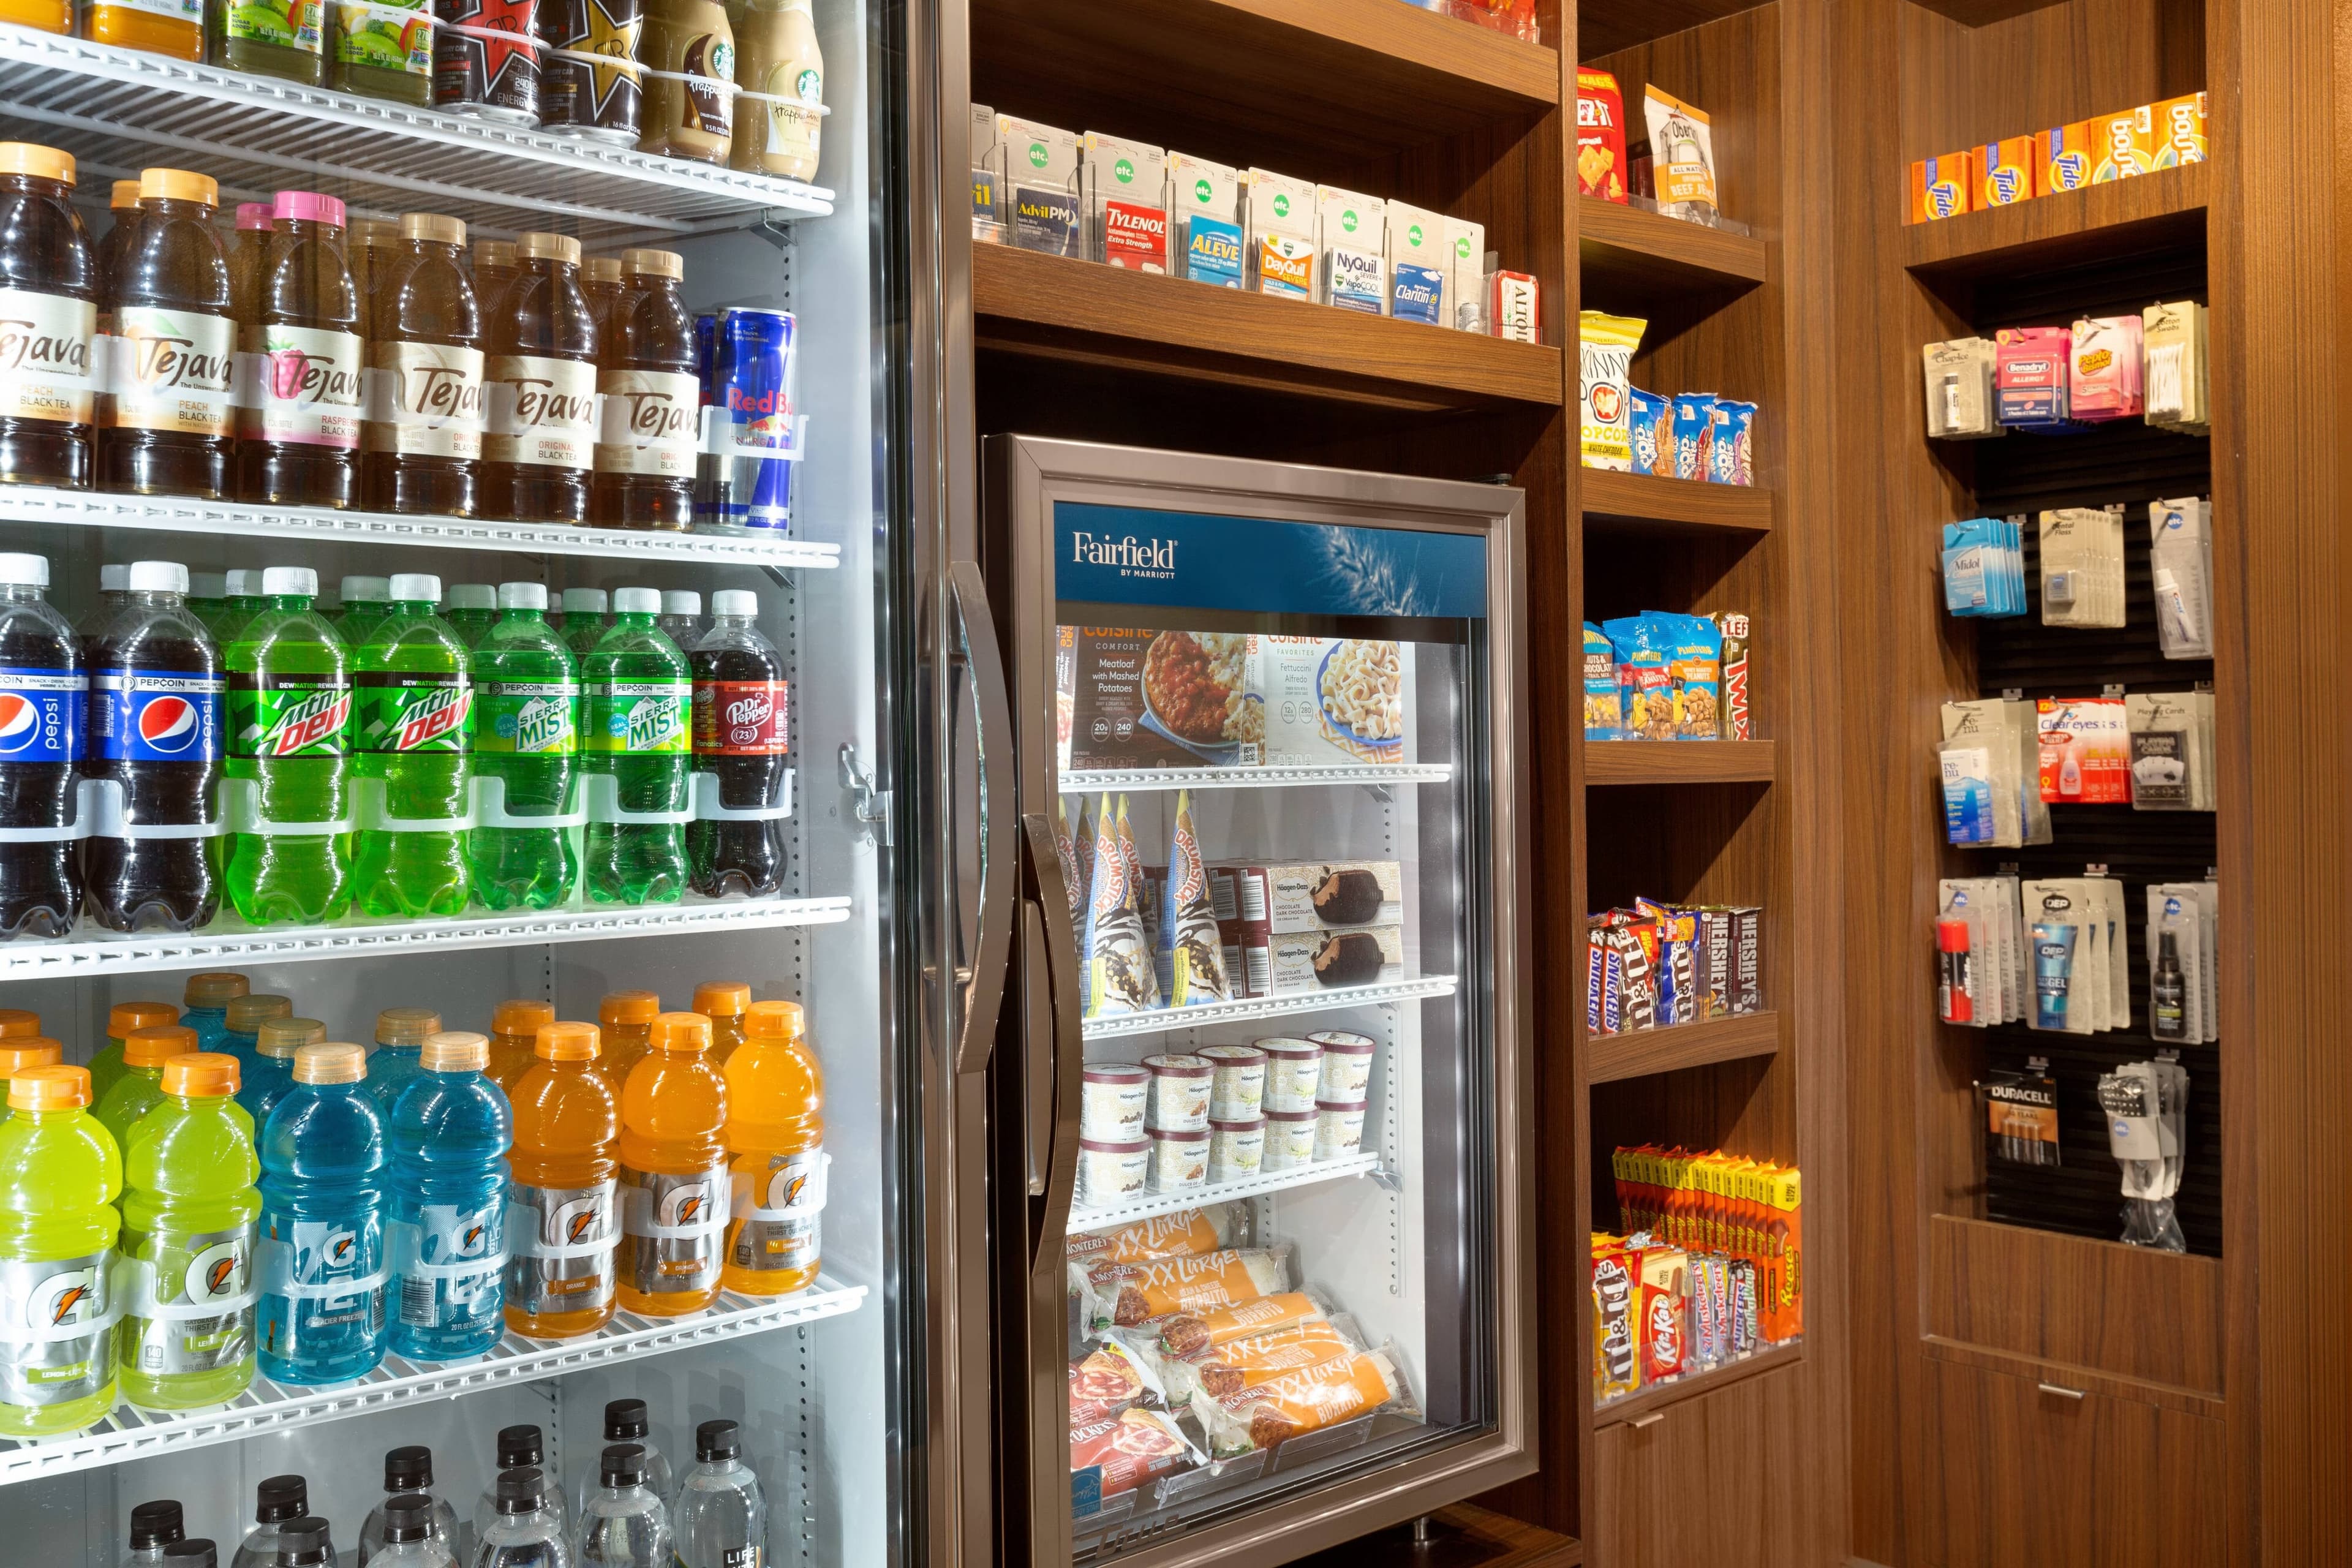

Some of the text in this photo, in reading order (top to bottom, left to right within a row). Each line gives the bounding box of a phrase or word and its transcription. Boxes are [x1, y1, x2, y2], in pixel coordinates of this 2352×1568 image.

[2056, 154, 2080, 189] Tide
[1670, 184, 1694, 197] BEEF
[1993, 169, 2015, 203] Tide
[1931, 183, 1953, 218] Tide
[1018, 202, 1070, 221] Advil PM
[1107, 208, 1165, 234] TYLENOL
[1107, 236, 1153, 250] Extra Strength
[1190, 235, 1240, 261] ALEVE
[1265, 255, 1306, 276] DayQuil
[1338, 252, 1376, 274] NyQuil
[1345, 278, 1380, 293] VapoCOOL
[1395, 284, 1430, 304] Claritin
[2157, 325, 2179, 334] Swabs
[140, 337, 233, 386] Tejava
[2010, 362, 2046, 372] Benadryl
[20, 396, 70, 409] BLACK TEA
[179, 401, 208, 412] PEACH
[728, 387, 772, 413] Red
[503, 379, 592, 437] Tejava
[179, 411, 222, 424] BLACK TEA
[322, 426, 345, 436] BLACK
[538, 440, 575, 452] ORIGINAL
[1589, 443, 1623, 457] WHITE CHEDDAR
[538, 450, 578, 461] BLACK TEA
[2052, 522, 2075, 531] Dental
[1073, 532, 1175, 570] Fairfield
[1954, 557, 1980, 571] Midol
[1134, 570, 1175, 579] MARRIOTT
[1099, 658, 1135, 669] Meatloaf
[1280, 663, 1311, 673] Fettuccini
[1285, 675, 1307, 684] Alfredo
[1098, 684, 1132, 693] Potatoes
[520, 697, 567, 726] SIERRA
[631, 698, 677, 725] SIERRA
[744, 698, 761, 710] Dr
[731, 701, 770, 725] Pepper
[43, 698, 61, 749] pepsi
[519, 705, 569, 750] MIST
[630, 705, 679, 748] MIST
[2041, 719, 2099, 731] Clear eyes
[739, 730, 748, 740] 23
[1094, 835, 1125, 914] DRUMSTICK
[1172, 829, 1201, 906] DRUMSTICK
[2048, 978, 2067, 988] GEL
[1604, 952, 1621, 1035] SNICKERS
[1991, 1085, 2051, 1104] DURACELL
[566, 1281, 586, 1290] ORANGE
[1235, 1305, 1284, 1327] BURRITO
[185, 1322, 209, 1332] THIRST
[146, 1348, 161, 1359] 140
[728, 1547, 755, 1564] LIFE
